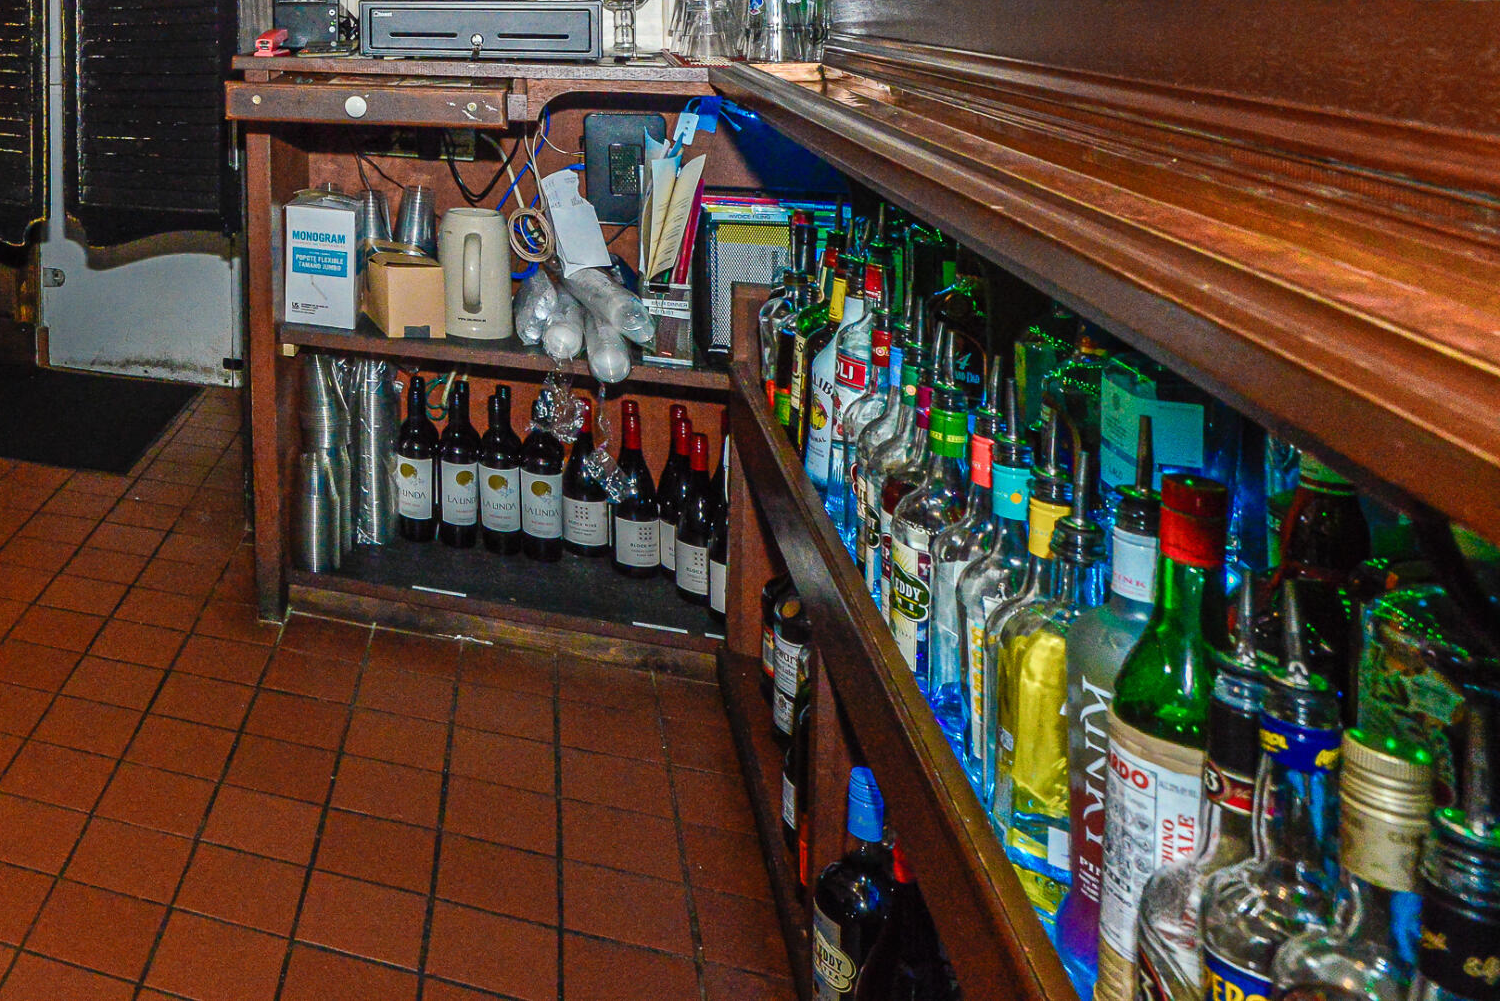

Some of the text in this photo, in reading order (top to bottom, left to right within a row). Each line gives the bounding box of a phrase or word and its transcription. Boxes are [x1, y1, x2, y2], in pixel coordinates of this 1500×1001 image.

[292, 230, 346, 244] MONOGRAM
[402, 489, 427, 499] LINDA
[492, 501, 517, 511] LINDA
[534, 507, 560, 518] LINDA
